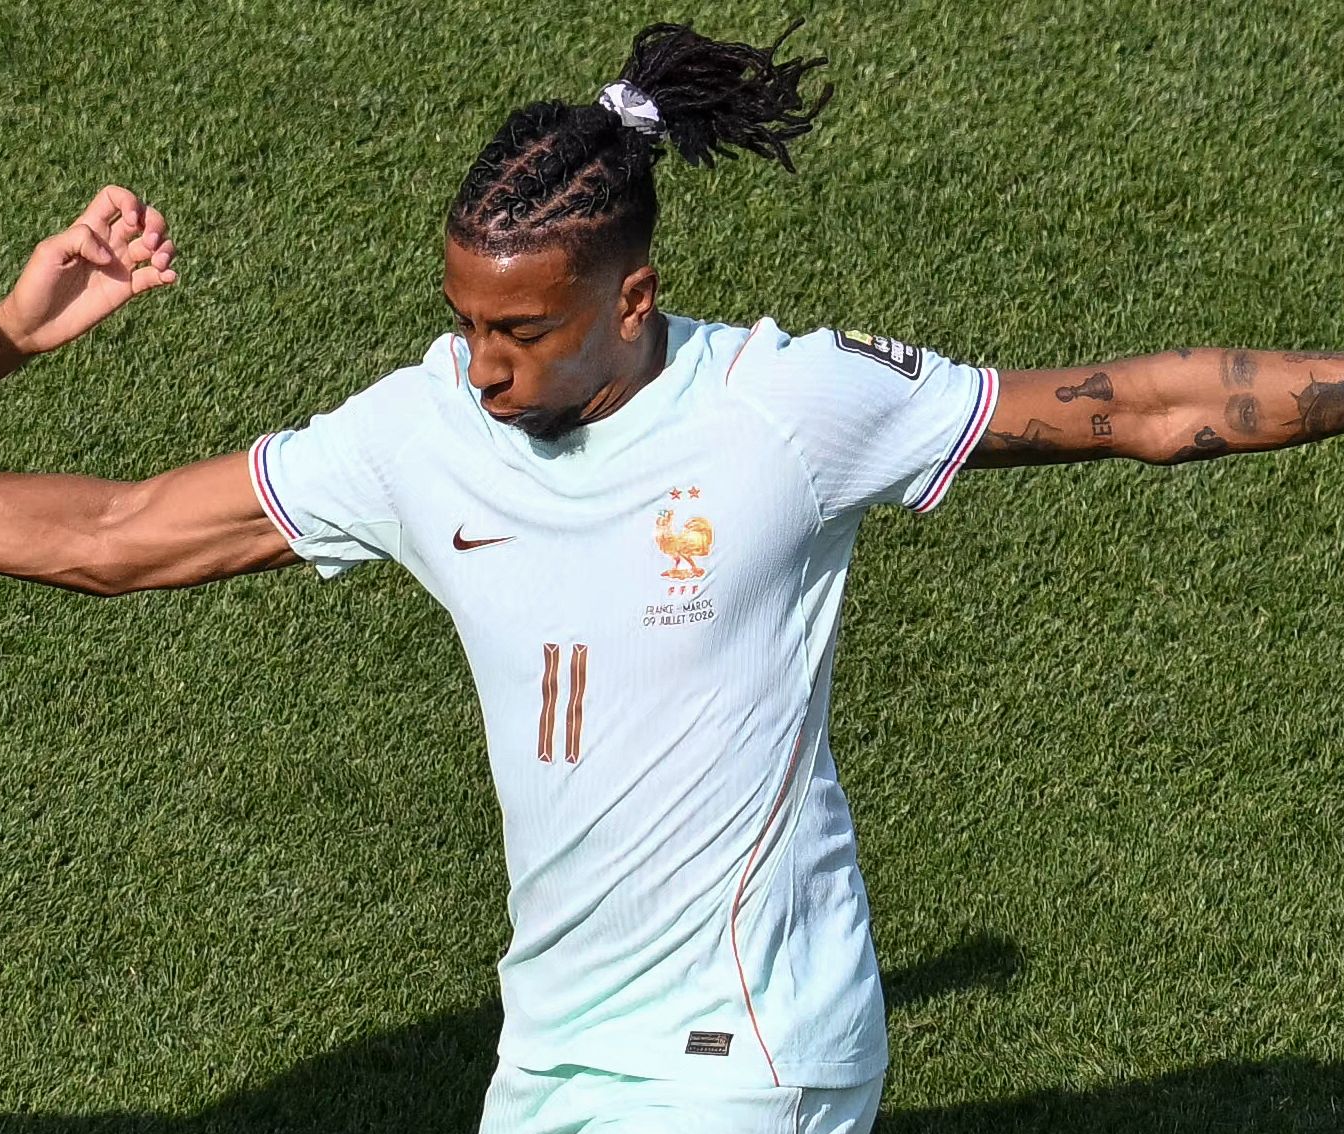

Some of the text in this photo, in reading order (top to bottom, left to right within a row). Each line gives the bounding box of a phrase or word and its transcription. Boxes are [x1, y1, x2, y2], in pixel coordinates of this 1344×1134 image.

[645, 604, 674, 615] FRANCE
[682, 598, 713, 612] MAROC
[642, 616, 656, 626] 09
[688, 610, 714, 623] 2026
[537, 642, 590, 764] 11
